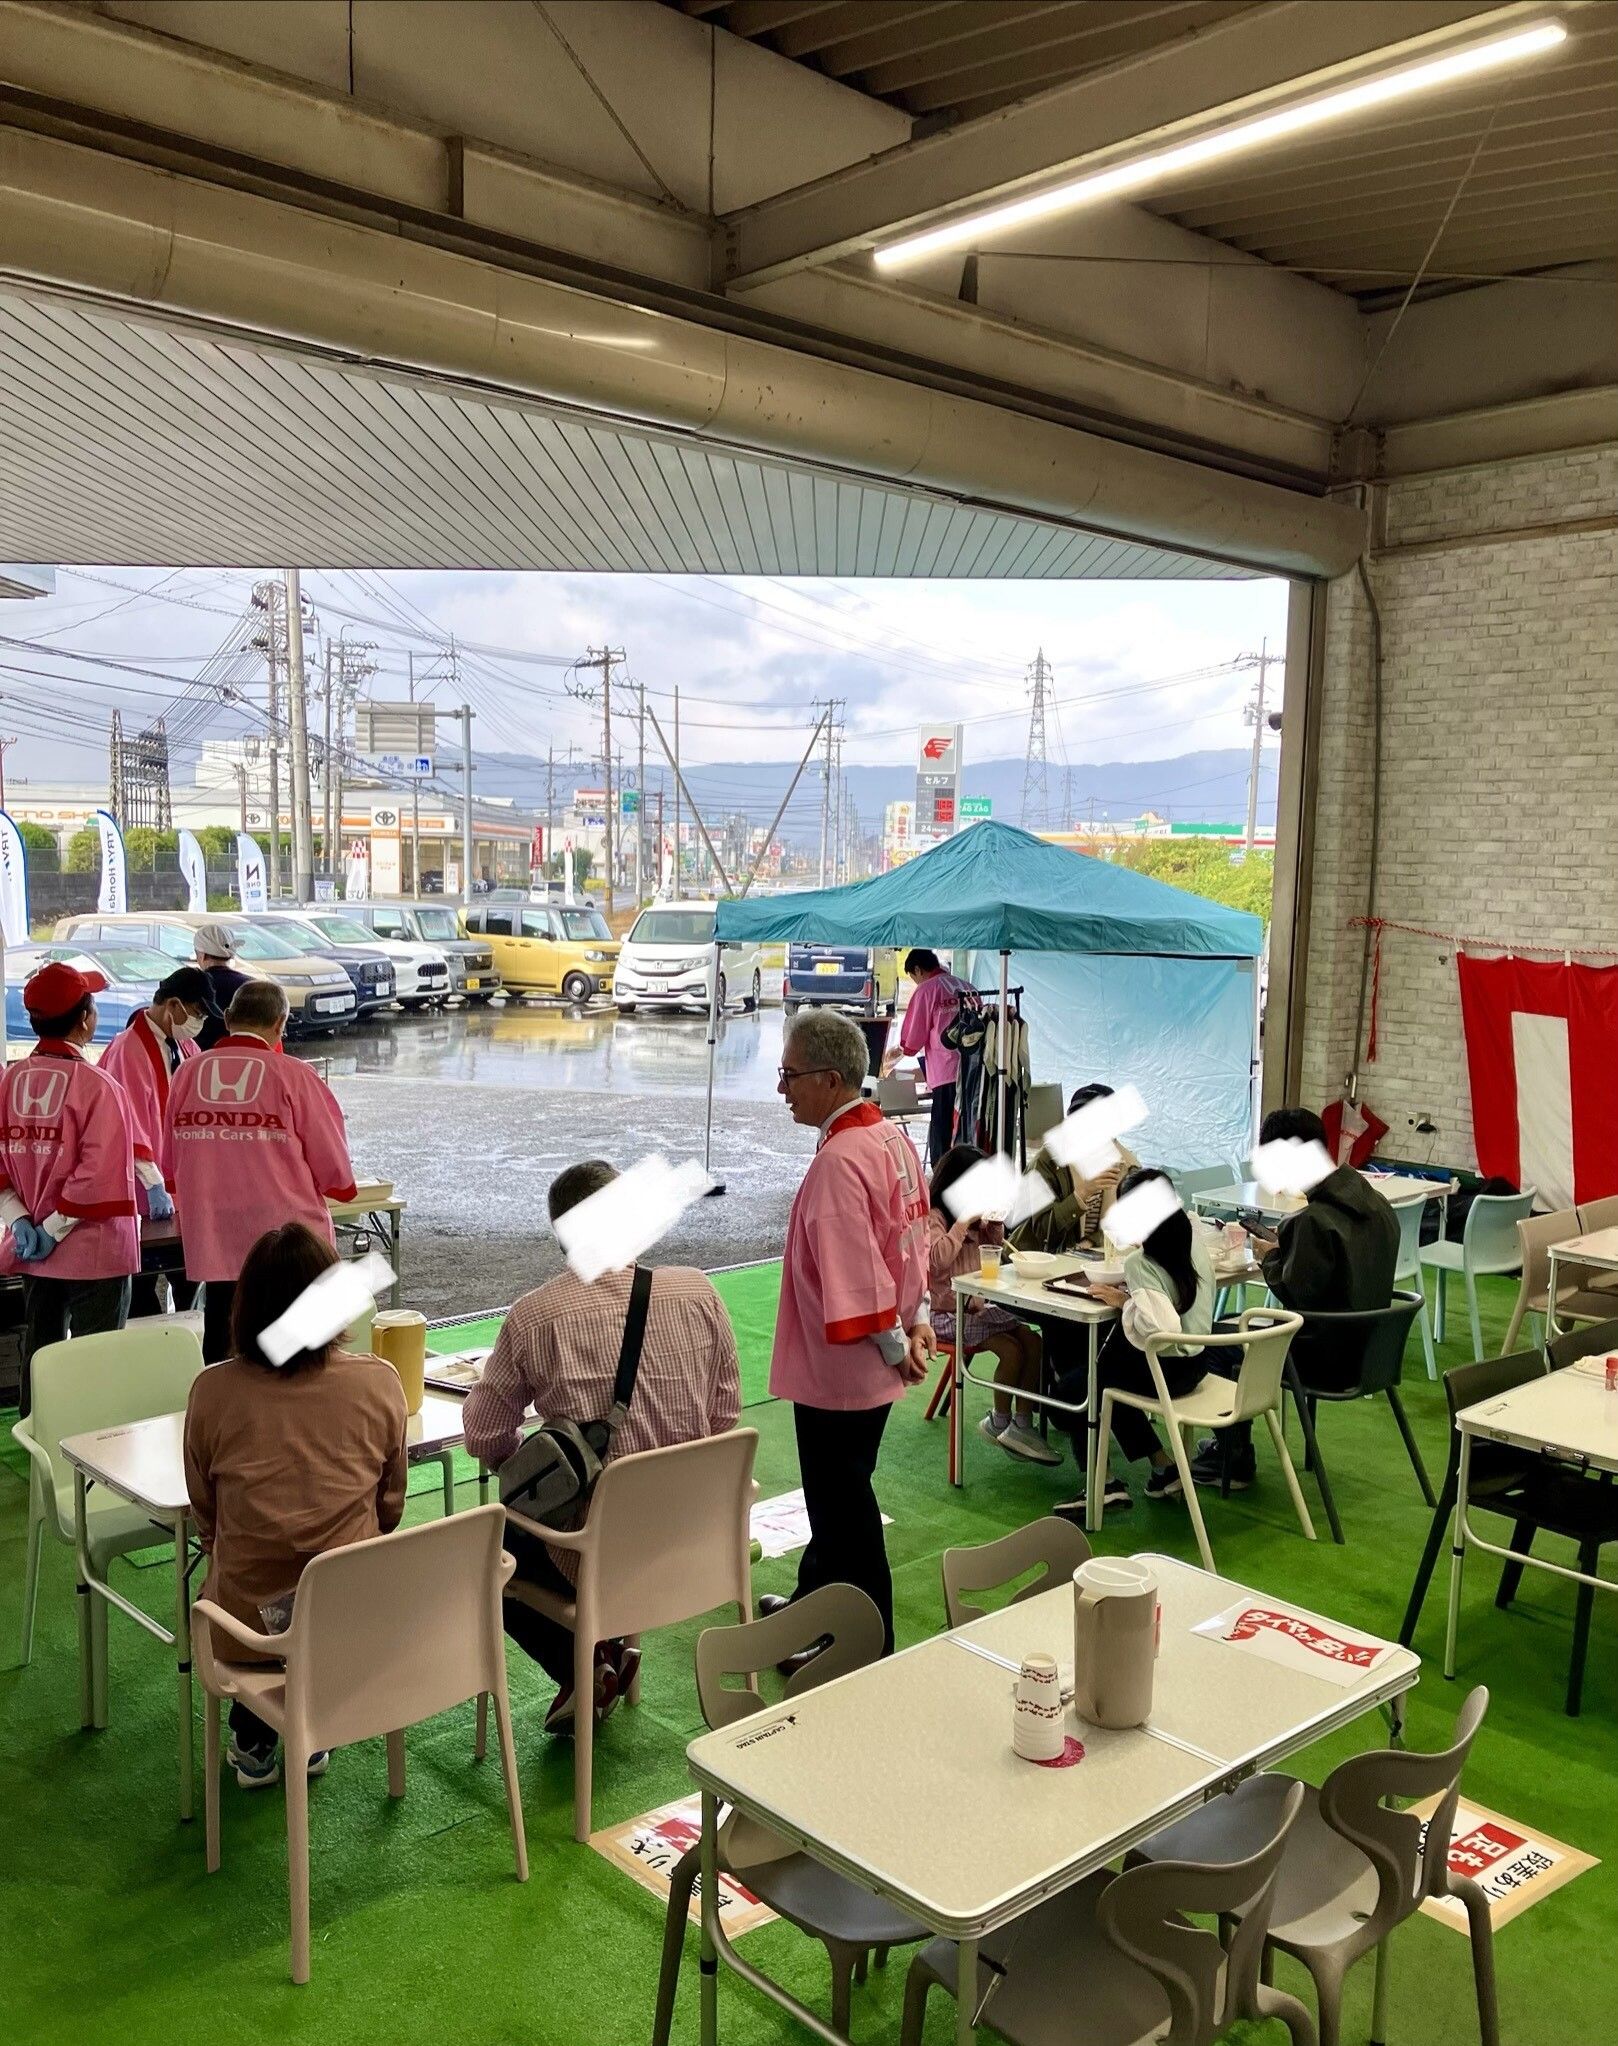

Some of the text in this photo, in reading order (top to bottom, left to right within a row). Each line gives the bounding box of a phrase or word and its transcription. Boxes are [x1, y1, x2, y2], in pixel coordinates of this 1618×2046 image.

[925, 776, 948, 785] セルフ
[174, 1111, 287, 1130] HONDA
[219, 1129, 253, 1140] Cars
[755, 1726, 786, 1742] CAPTAIN
[736, 1739, 756, 1749] STAG
[1482, 1851, 1555, 1899] 段差あり
